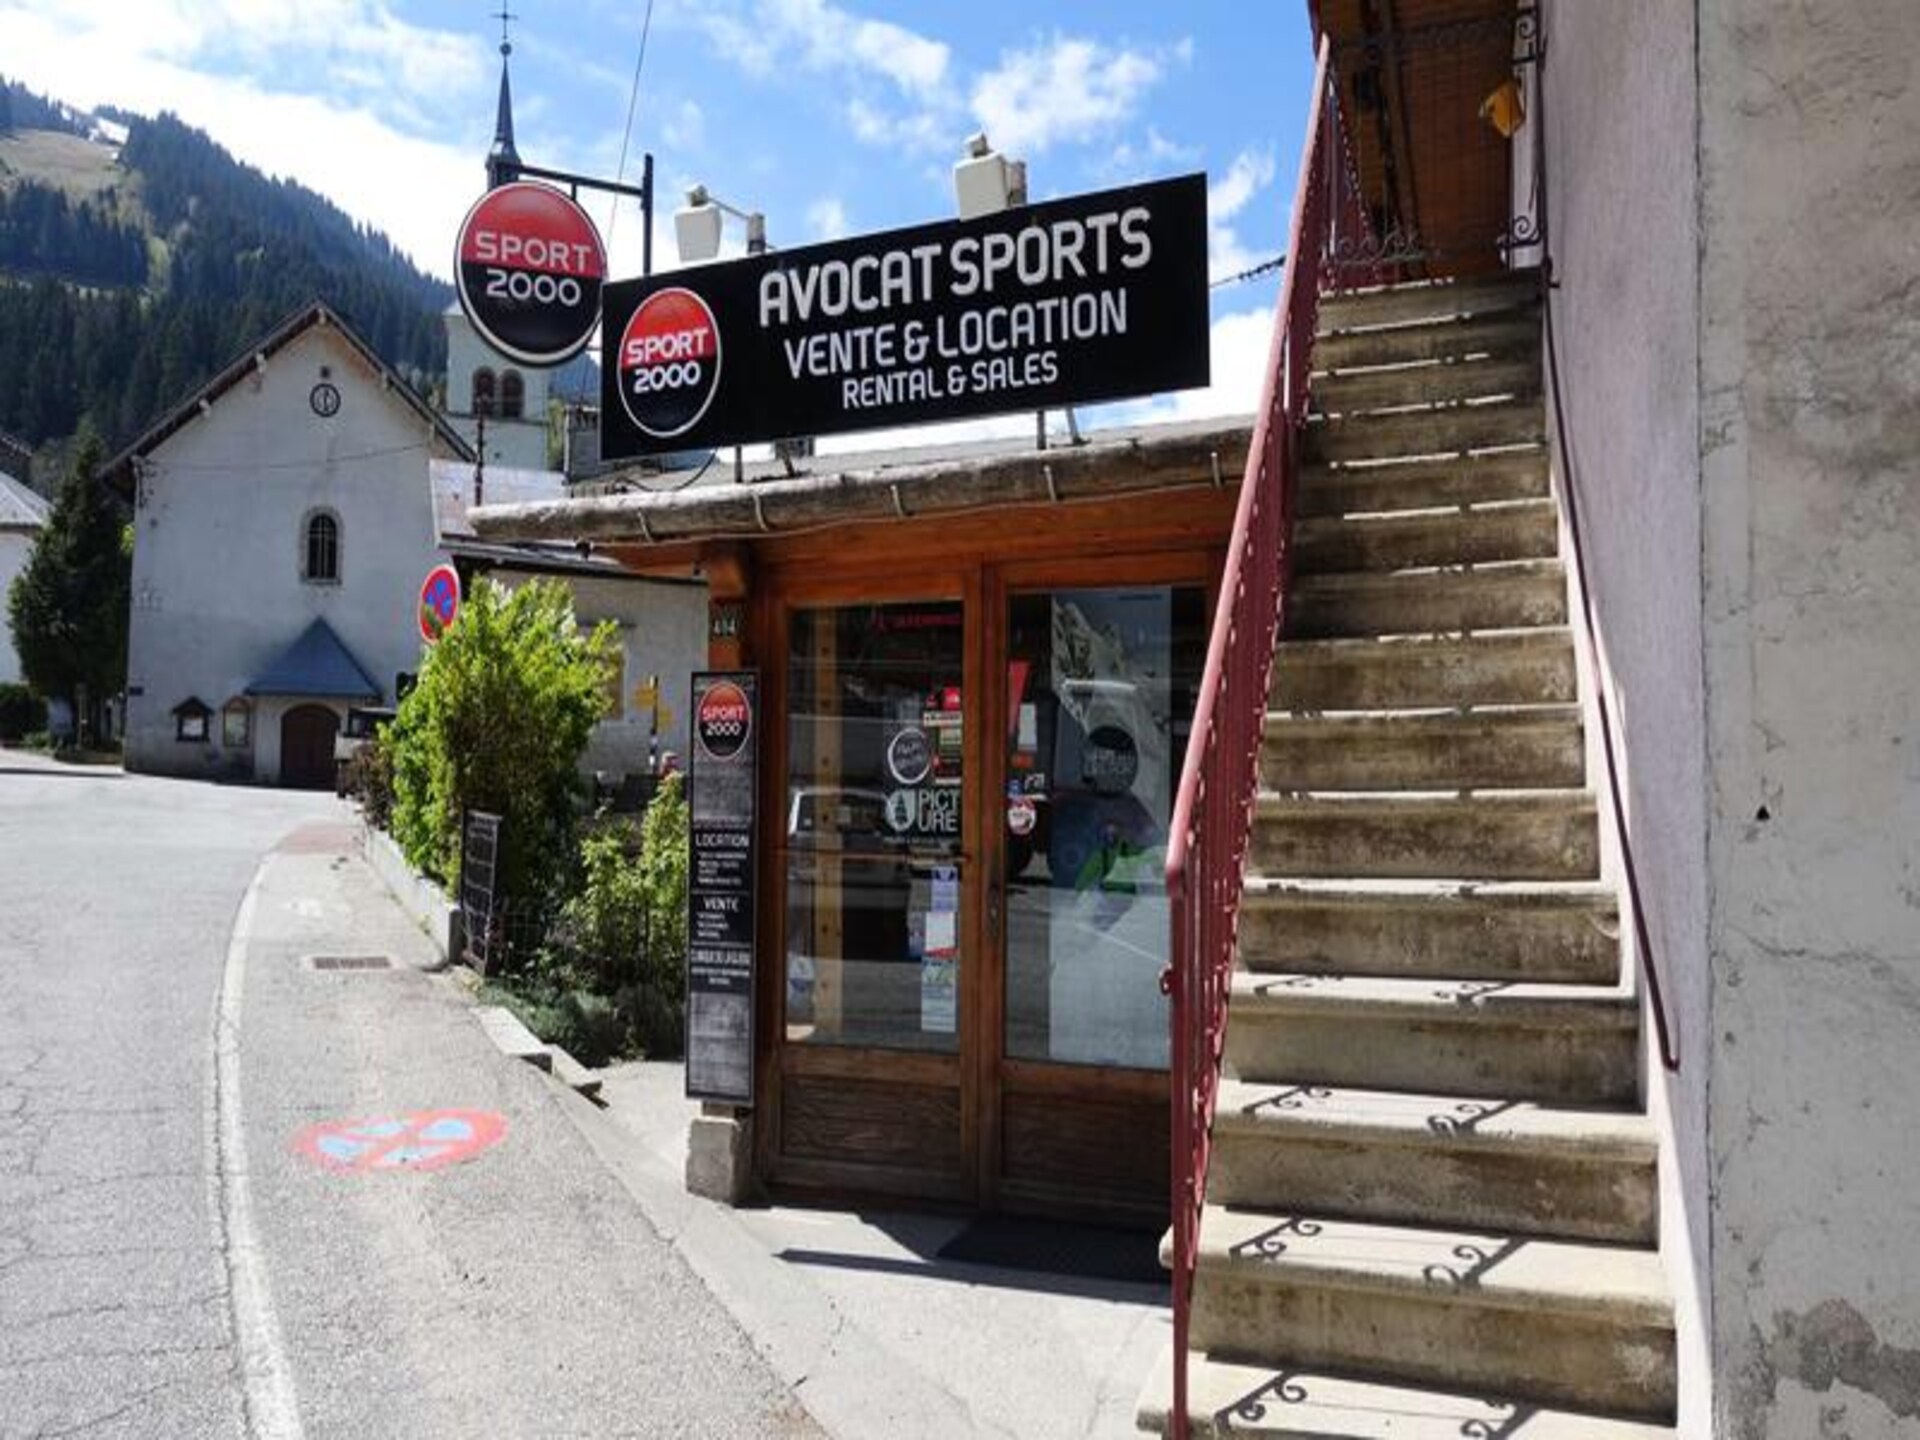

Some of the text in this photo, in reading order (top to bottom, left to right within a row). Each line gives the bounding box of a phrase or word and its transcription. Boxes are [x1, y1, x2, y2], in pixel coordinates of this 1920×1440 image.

[475, 230, 591, 272] SPORT
[760, 206, 1153, 327] AVOCAT SPORTS
[486, 268, 582, 307] 2000
[626, 327, 708, 364] SPORT
[783, 288, 1127, 379] VENTE & LOCATION
[633, 360, 701, 393] 2000
[843, 350, 1058, 409] RENTAL & SALES
[702, 705, 744, 721] SPORT
[706, 722, 741, 736] 2000
[918, 789, 961, 810] PICT
[918, 809, 958, 832] URE
[695, 833, 750, 847] LOCATION
